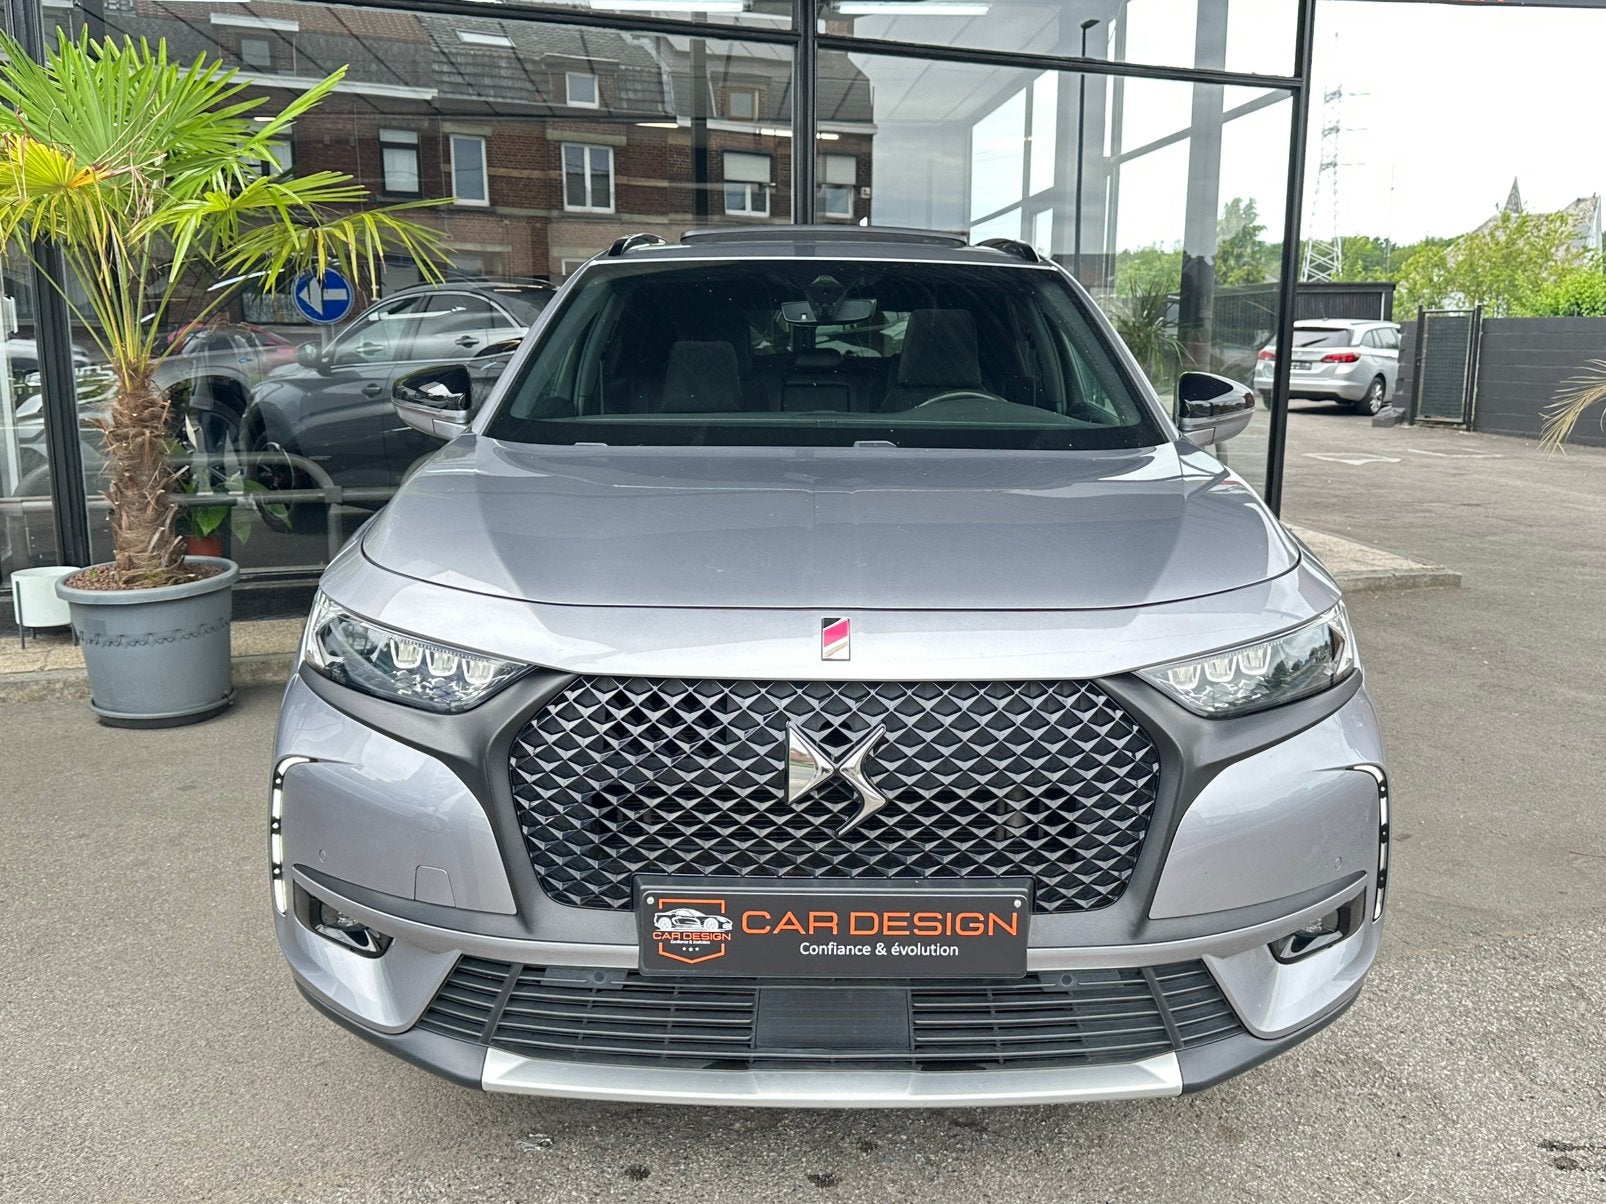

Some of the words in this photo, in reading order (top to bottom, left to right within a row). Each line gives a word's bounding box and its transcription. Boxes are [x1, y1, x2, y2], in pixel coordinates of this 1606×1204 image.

[741, 910, 839, 936] CAR
[849, 911, 1019, 937] DESIGN
[652, 932, 681, 940] CAR
[683, 932, 731, 941] DESIGN
[799, 941, 872, 956] Confiance
[874, 942, 888, 956] &
[890, 941, 959, 957] évolution
